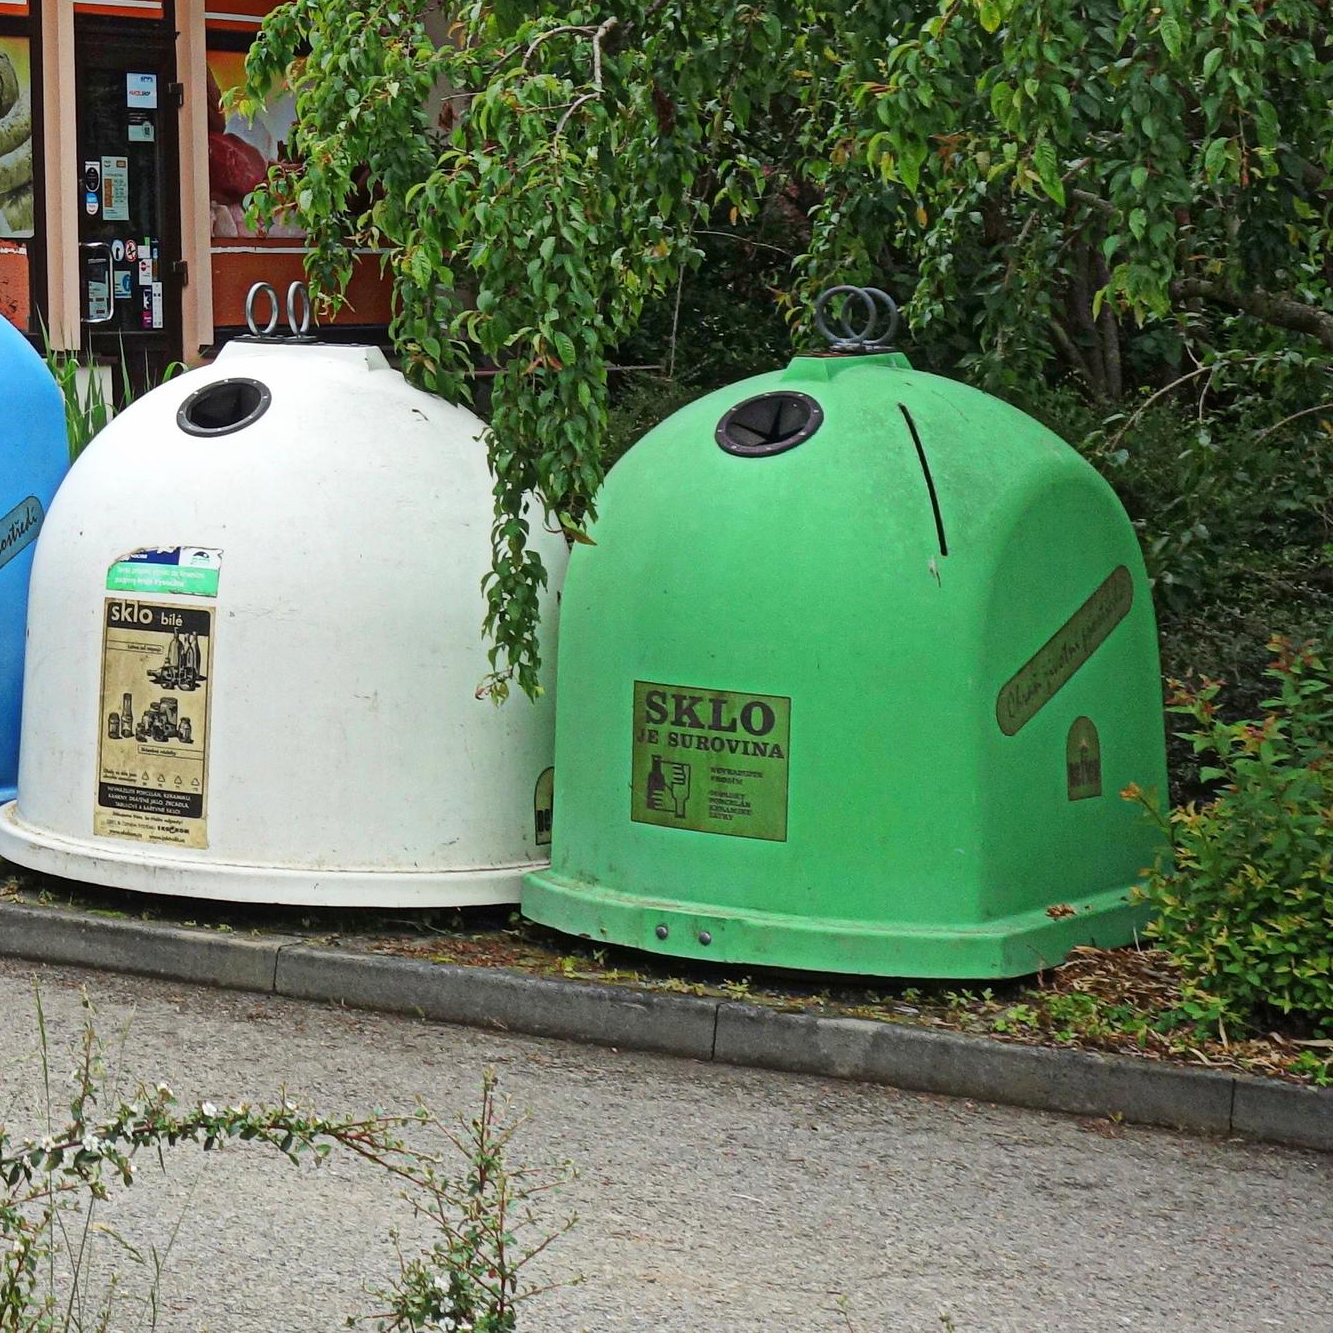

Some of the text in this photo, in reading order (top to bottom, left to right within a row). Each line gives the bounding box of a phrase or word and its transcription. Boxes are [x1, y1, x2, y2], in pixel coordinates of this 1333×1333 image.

[111, 600, 183, 627] sklo bílé
[645, 690, 776, 736] SKLO
[636, 728, 784, 759] JE SUROVINA
